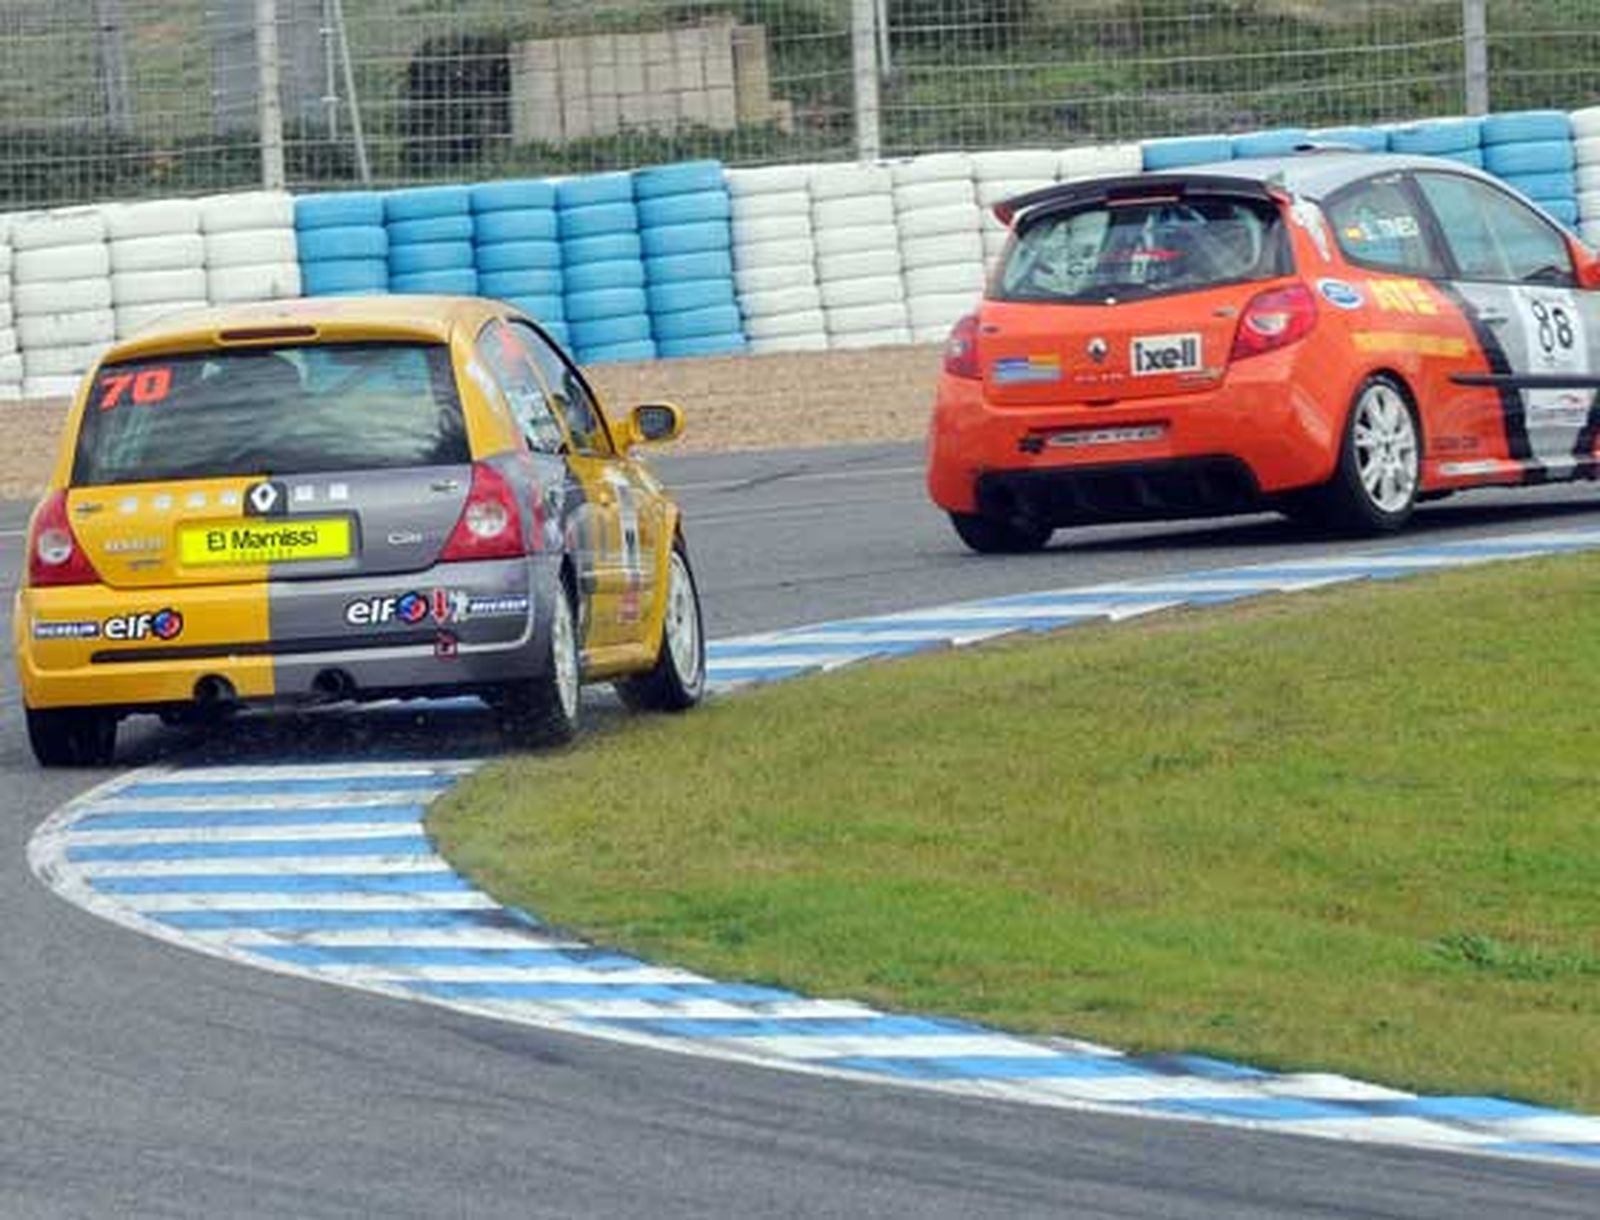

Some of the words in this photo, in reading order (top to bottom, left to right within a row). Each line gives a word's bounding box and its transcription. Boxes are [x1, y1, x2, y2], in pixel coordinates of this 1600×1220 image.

[1532, 300, 1573, 352] 88
[1133, 338, 1198, 373] ixell
[100, 369, 172, 411] 70
[206, 530, 227, 552] El
[103, 613, 152, 639] elf
[346, 598, 397, 624] elf
